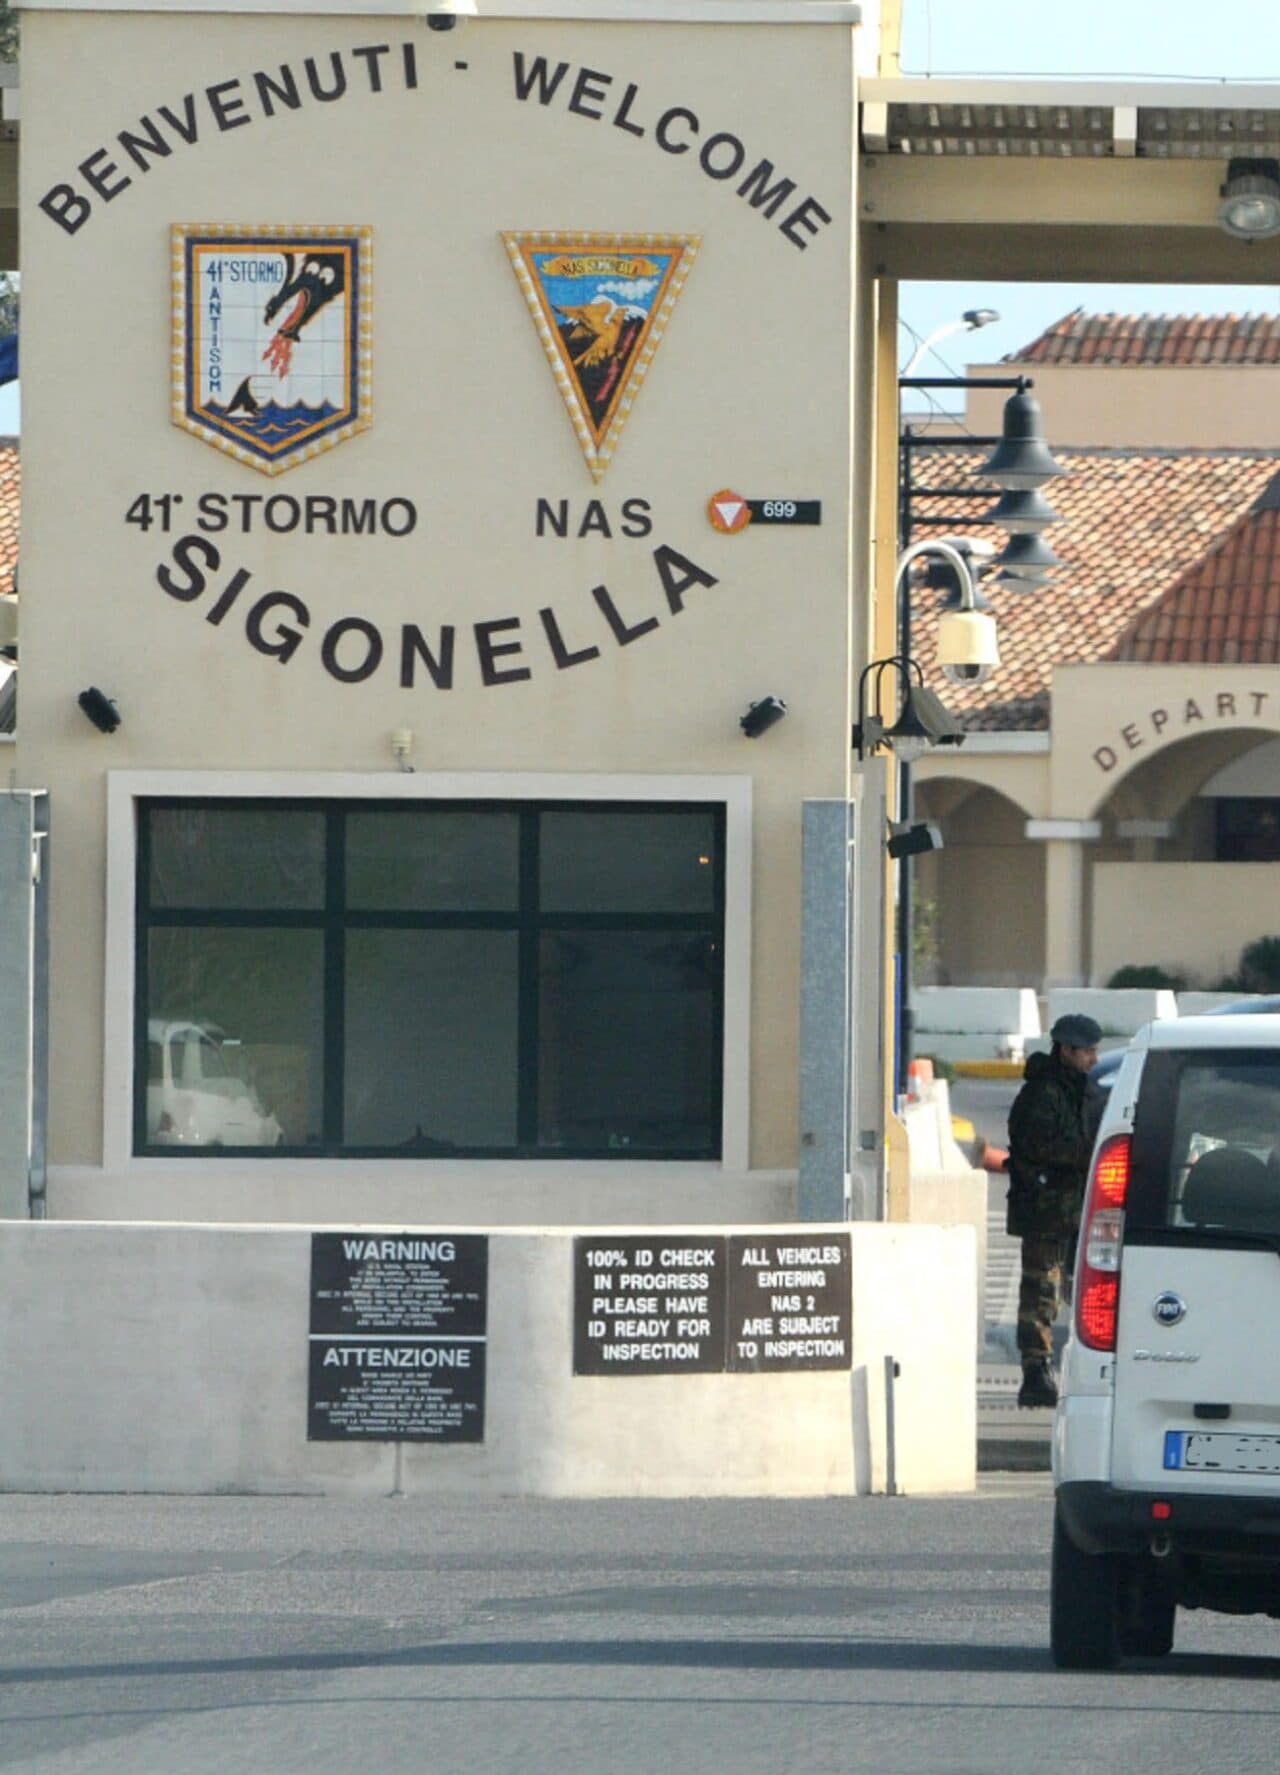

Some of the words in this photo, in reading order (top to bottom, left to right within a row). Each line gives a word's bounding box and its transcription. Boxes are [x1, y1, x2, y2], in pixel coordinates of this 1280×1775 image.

[39, 42, 418, 235] BENVENUTI
[512, 51, 833, 251] WELCOME
[197, 493, 418, 537] STORMO
[535, 498, 654, 538] NAS
[763, 501, 797, 518] 699
[156, 534, 720, 691] SIGONELLA
[342, 1240, 456, 1261] WARNING
[586, 1250, 628, 1267] 100%
[635, 1249, 653, 1266] ID
[660, 1249, 715, 1266] CHECK
[742, 1248, 770, 1266] ALL
[776, 1246, 841, 1265] VEHICLES
[594, 1274, 612, 1290] IN
[620, 1273, 709, 1290] PROGRESS
[758, 1270, 826, 1288] ENTERING
[592, 1297, 658, 1314] PLEASE
[665, 1296, 708, 1313] HAVE
[771, 1295, 801, 1312] NAS
[806, 1295, 815, 1311] 2
[588, 1320, 606, 1337] ID
[614, 1319, 670, 1337] READY
[677, 1319, 710, 1337] FOR
[742, 1318, 773, 1336] ARE
[779, 1316, 840, 1335] SUBJECT
[322, 1347, 471, 1367] ATTENZIONE
[602, 1342, 699, 1360] INSPECTION
[737, 1341, 758, 1358] TO
[764, 1339, 845, 1357] INSPECTION
